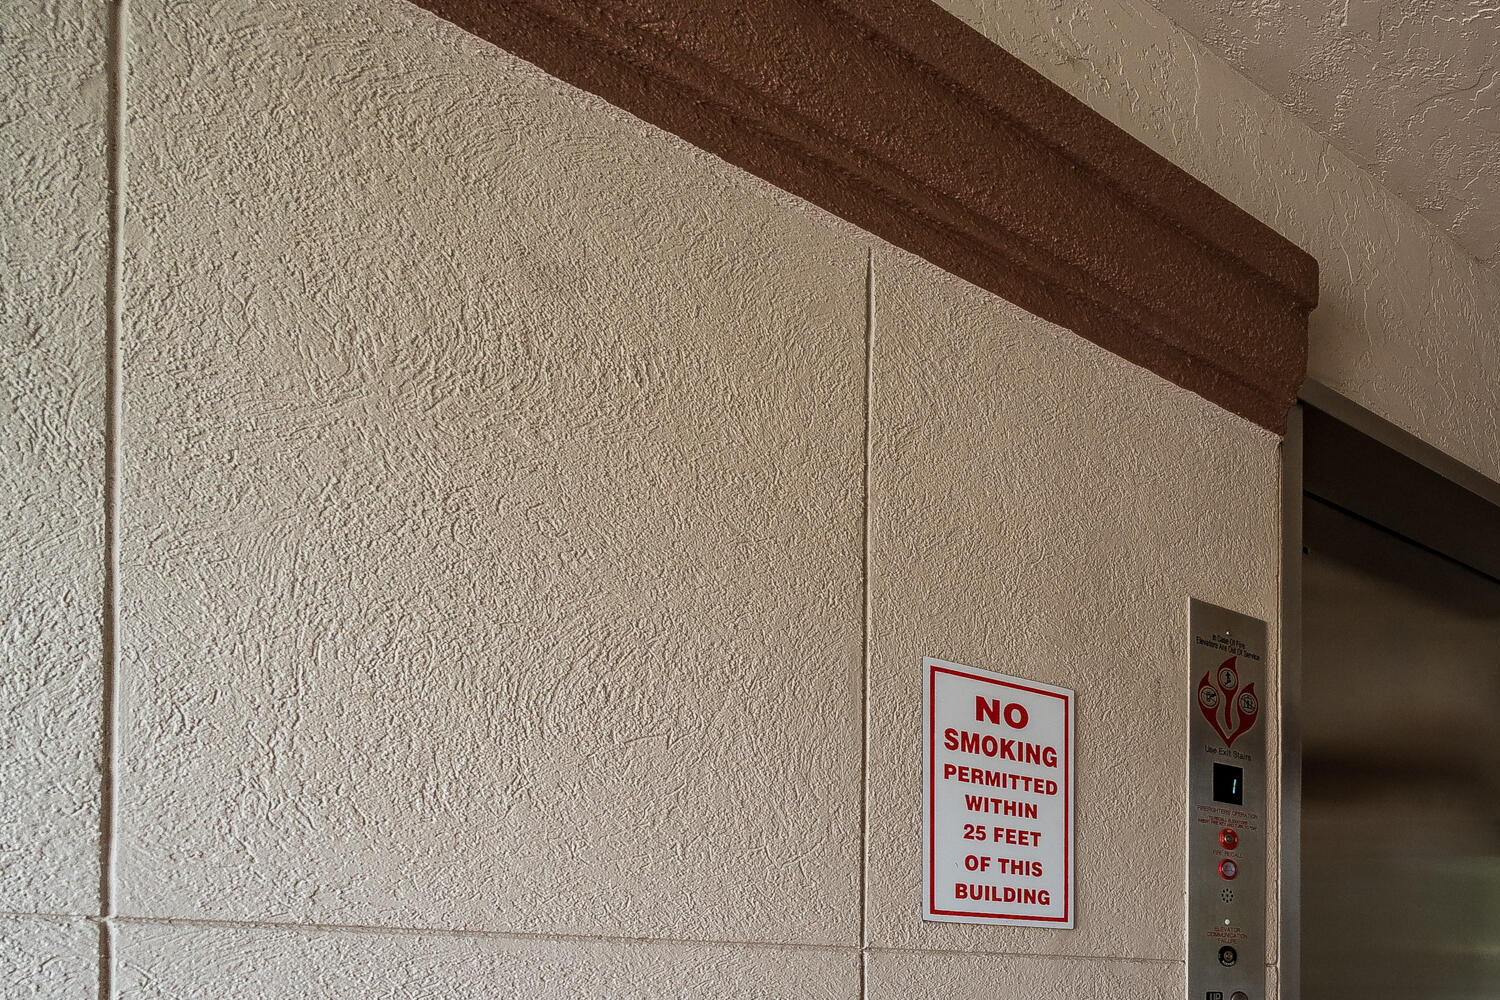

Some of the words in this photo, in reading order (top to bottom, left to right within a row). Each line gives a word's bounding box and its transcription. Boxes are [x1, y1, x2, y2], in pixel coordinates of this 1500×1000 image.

[975, 695, 1029, 729] NO
[944, 728, 1058, 768] SMOKING
[1204, 745, 1217, 754] Use
[1218, 748, 1231, 757] Exit
[1233, 751, 1252, 761] Stairs
[944, 763, 1058, 796] PERMITTED
[1232, 779, 1237, 794] 1
[965, 794, 1038, 819] WITHIN
[963, 824, 987, 841] 25
[993, 826, 1042, 847] FEET
[964, 855, 991, 872] OF
[998, 858, 1043, 877] THIS
[955, 883, 1050, 905] BUILDING
